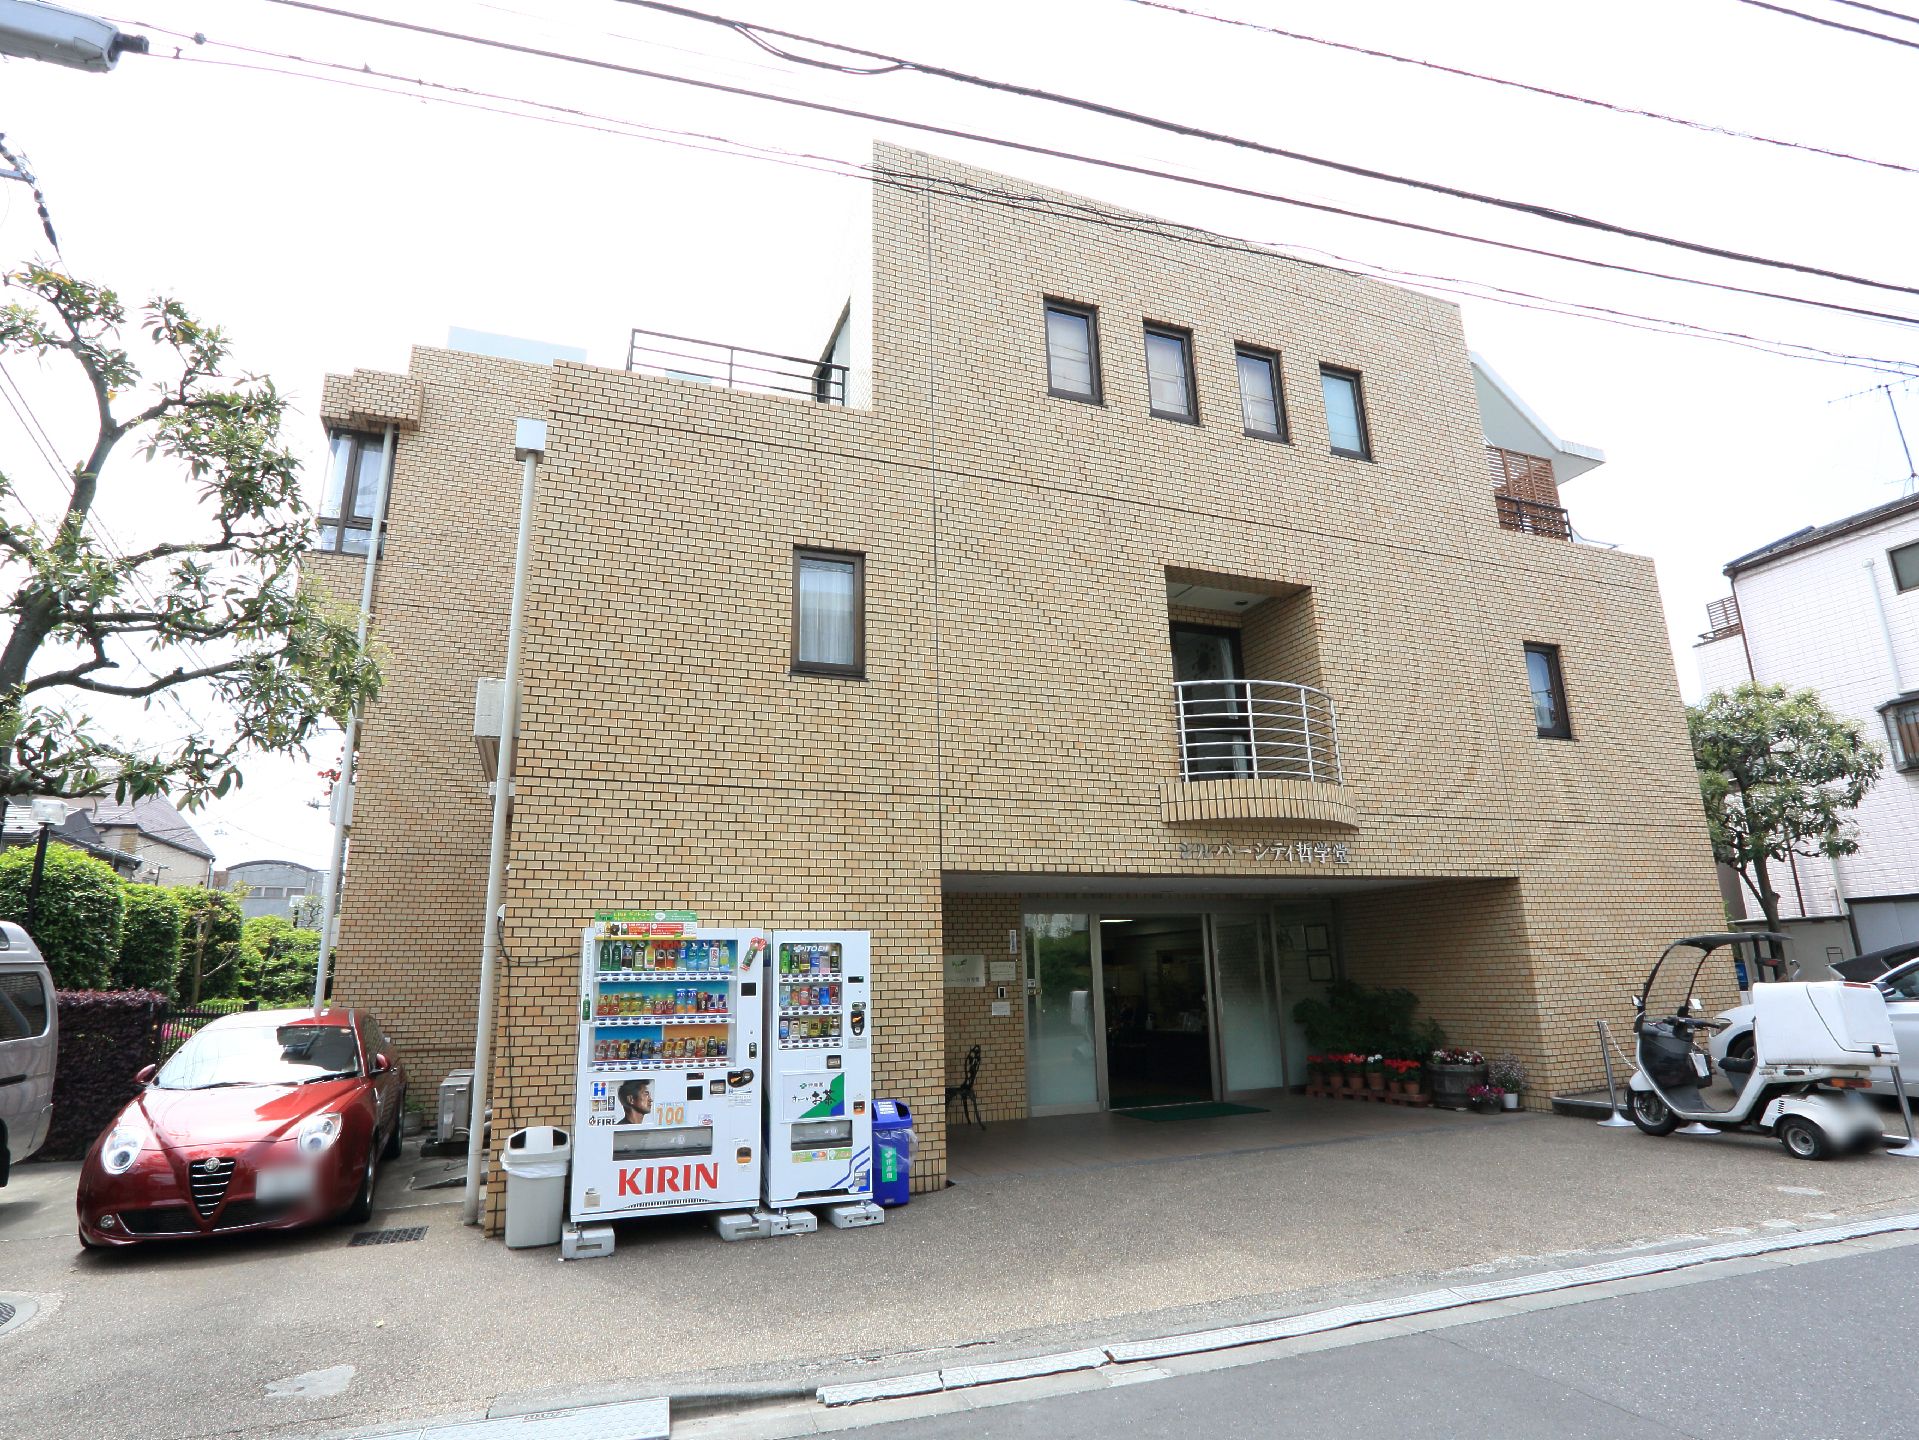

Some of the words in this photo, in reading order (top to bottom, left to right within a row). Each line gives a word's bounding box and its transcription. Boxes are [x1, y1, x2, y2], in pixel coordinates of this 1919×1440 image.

[1179, 840, 1350, 864] シルバーシティ哲学堂
[618, 1162, 719, 1197] KIRIN
